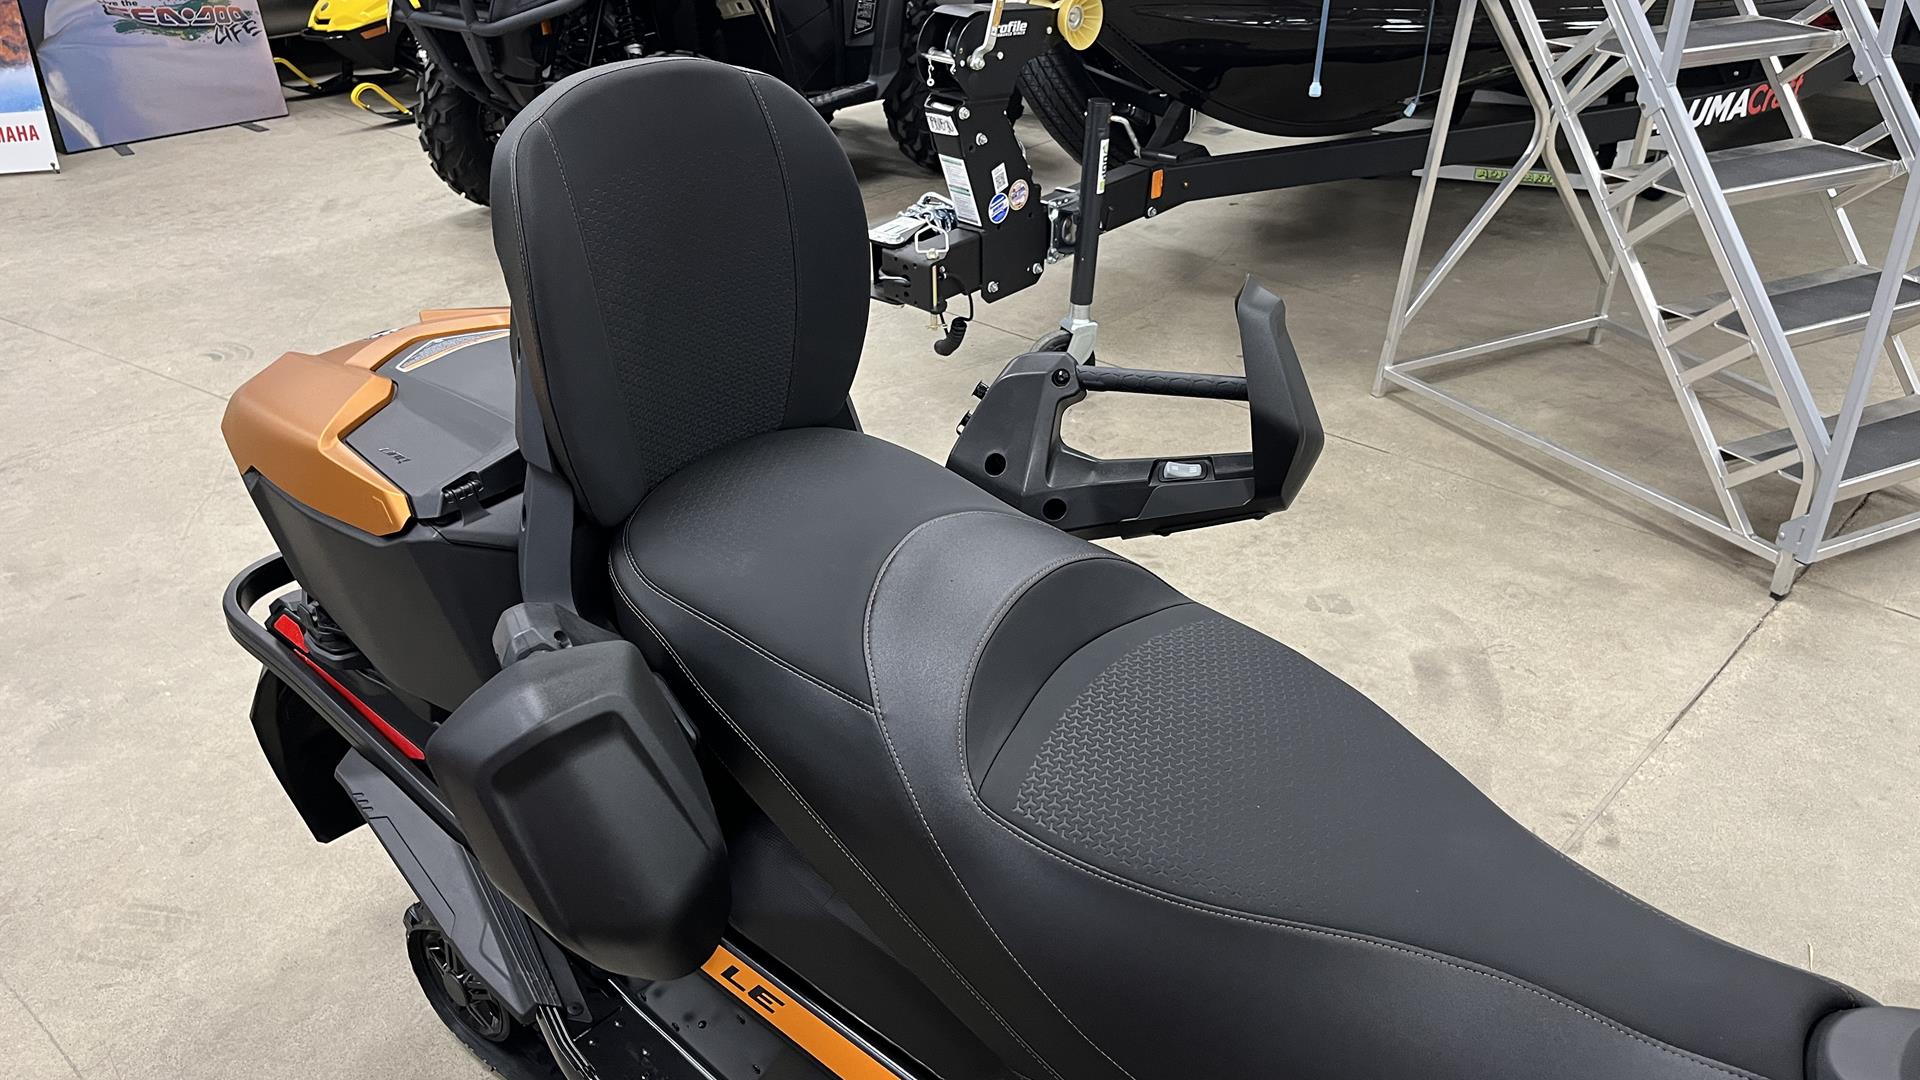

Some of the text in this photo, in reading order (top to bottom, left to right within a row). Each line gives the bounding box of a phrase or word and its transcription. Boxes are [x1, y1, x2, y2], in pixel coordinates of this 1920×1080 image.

[214, 20, 262, 45] LIFE
[992, 20, 1028, 35] rofile
[720, 965, 786, 1014] LE
